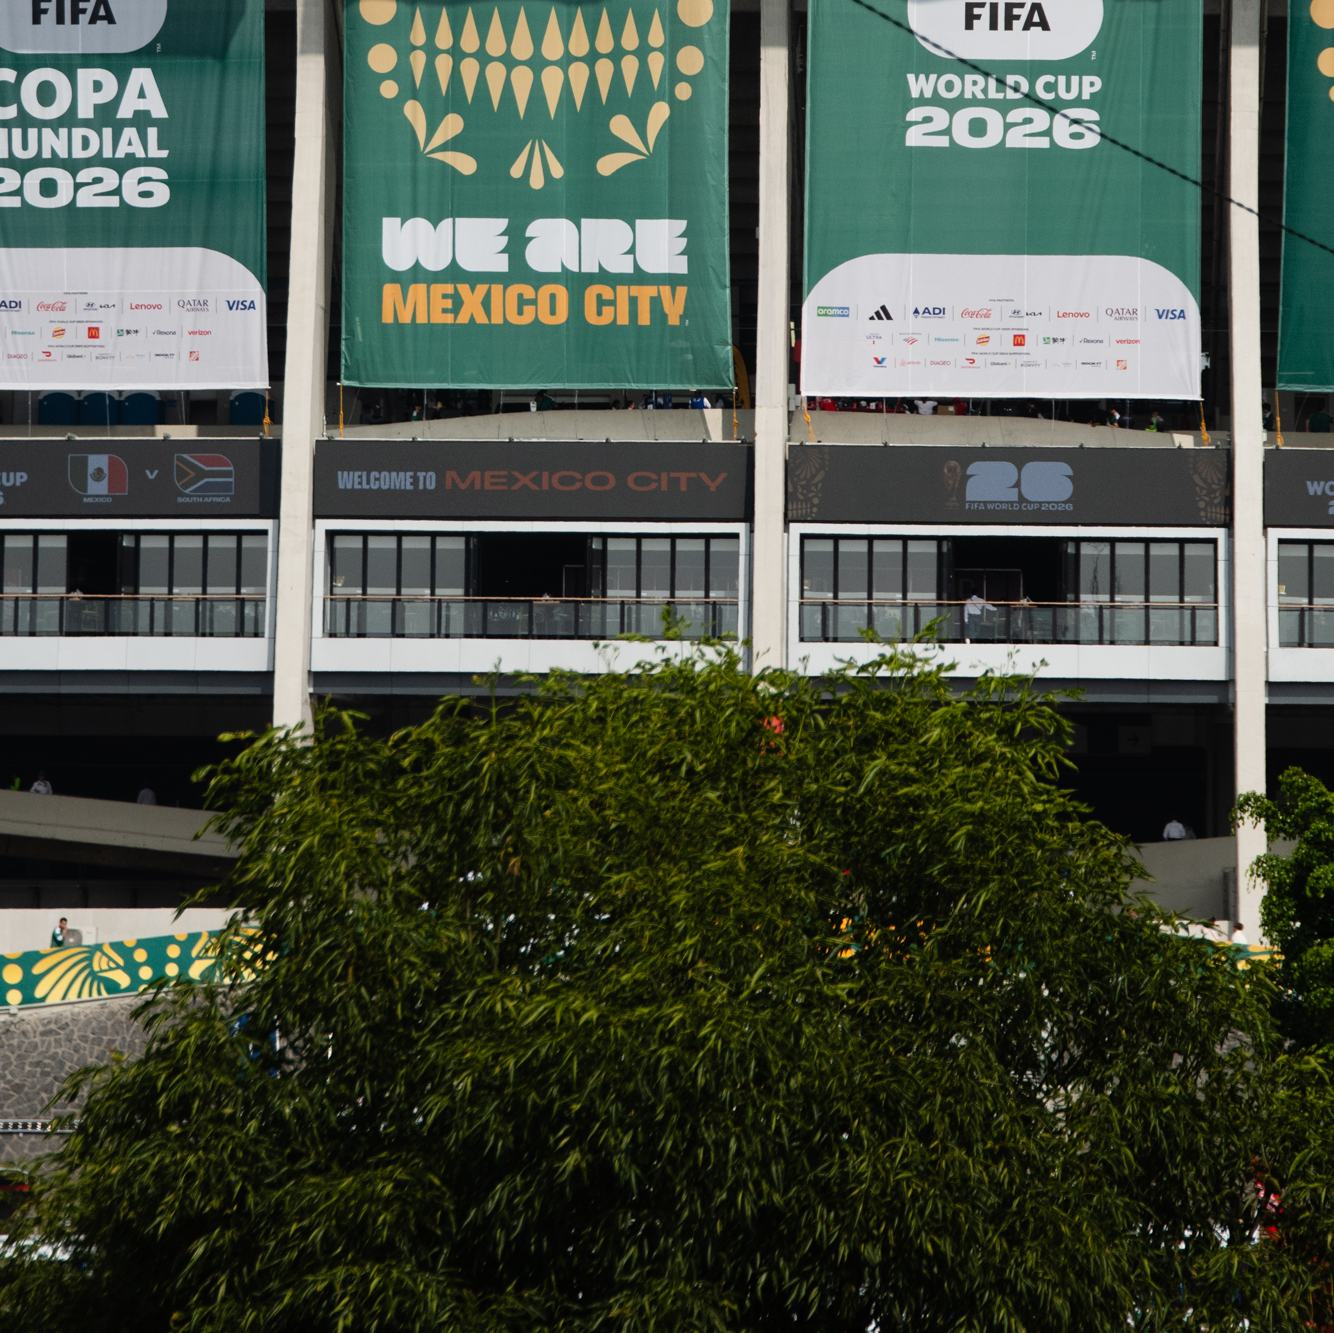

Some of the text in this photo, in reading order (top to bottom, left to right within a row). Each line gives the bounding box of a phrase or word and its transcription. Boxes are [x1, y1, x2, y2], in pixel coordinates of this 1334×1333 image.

[964, 2, 1051, 31] FIFA
[906, 73, 1102, 100] WORLD CUP
[905, 106, 1102, 149] 2026
[381, 217, 688, 274] WE ARE
[130, 302, 163, 310] Lenovo
[177, 299, 209, 308] QATAR
[225, 299, 257, 311] VISA
[381, 283, 688, 326] MEXICO CITY
[817, 307, 849, 316] aramco
[921, 307, 946, 316] ADI
[1105, 307, 1138, 317] QATAR
[1154, 309, 1187, 320] VISA
[337, 470, 728, 492] WELCOME TO MEXICO CITY
[965, 461, 1074, 502] 26
[1041, 503, 1074, 511] 2026
